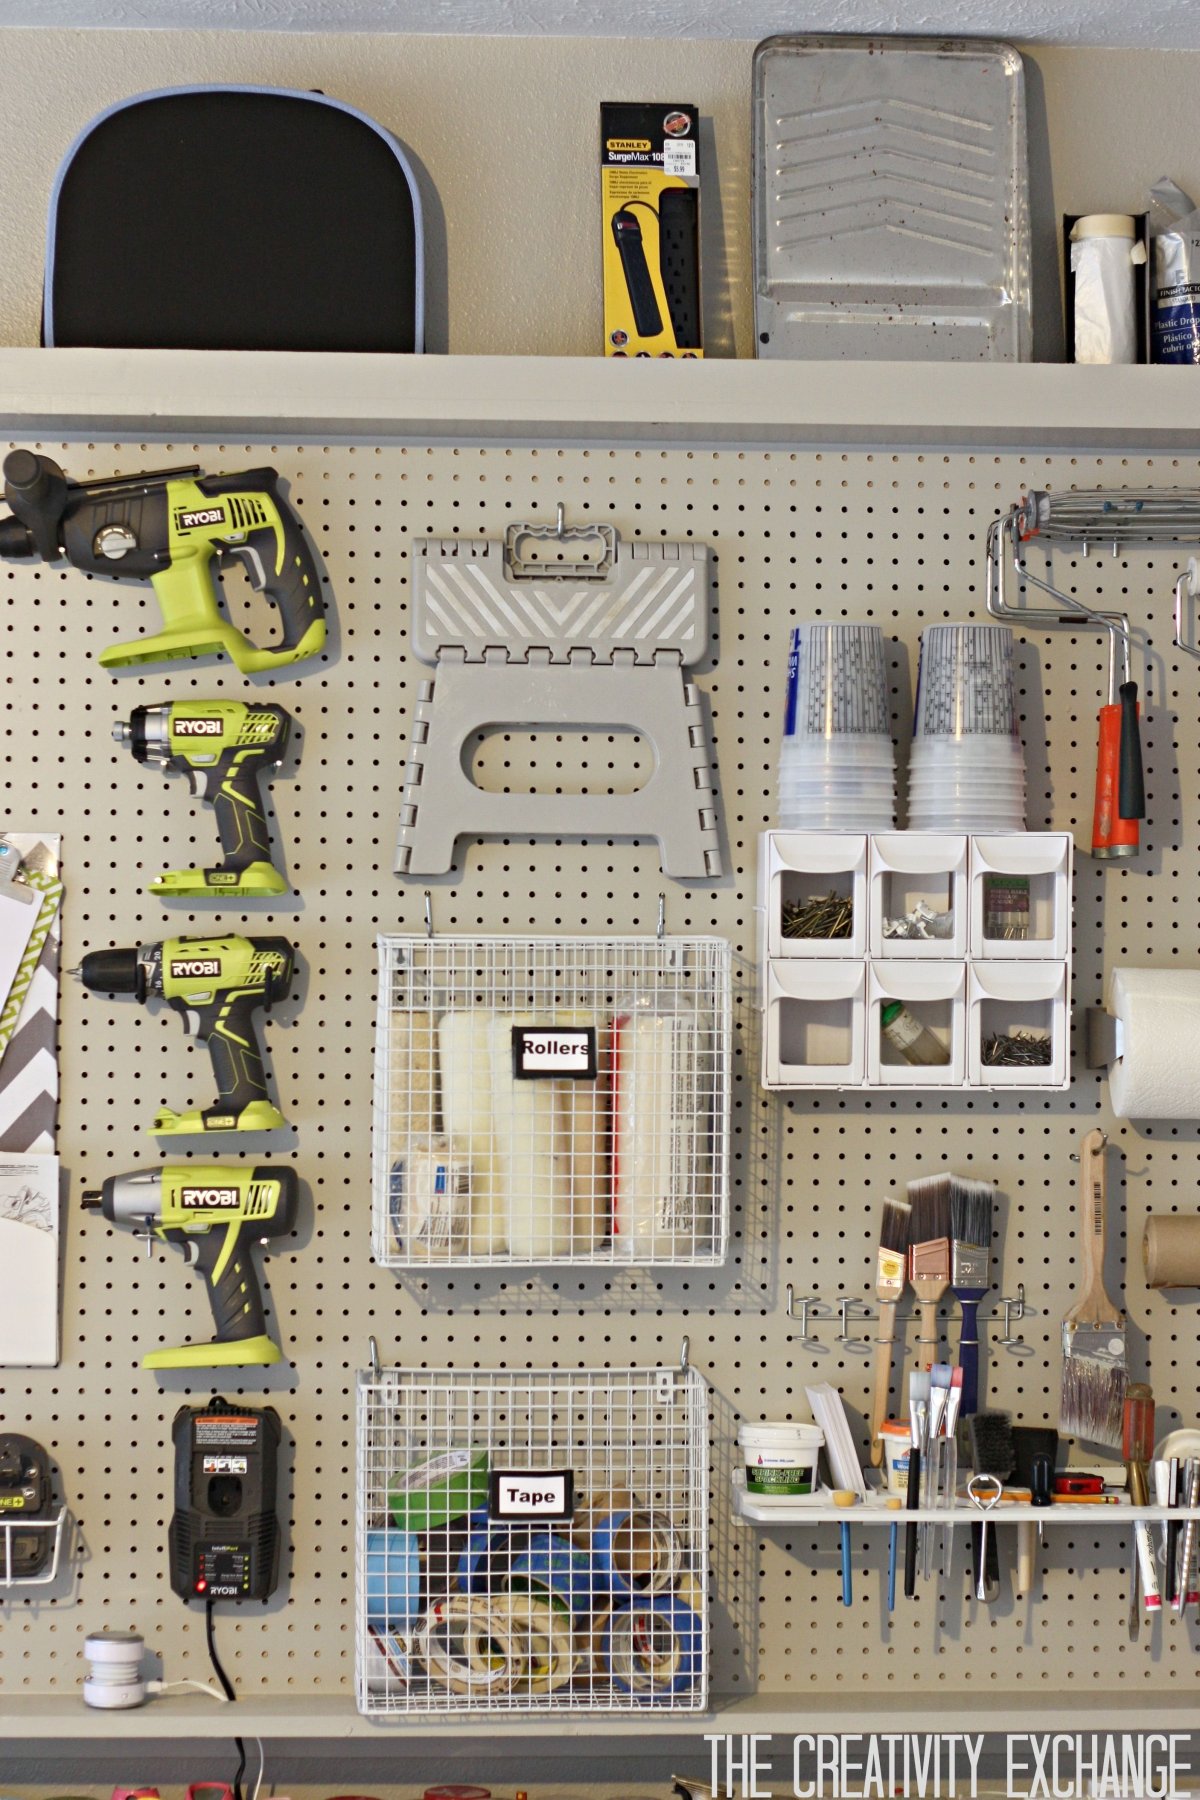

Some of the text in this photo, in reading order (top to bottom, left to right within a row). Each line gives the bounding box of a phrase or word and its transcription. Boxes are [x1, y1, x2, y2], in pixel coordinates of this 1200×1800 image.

[609, 141, 648, 149] STANLEY
[608, 152, 649, 162] SurgeMax
[1162, 344, 1184, 354] cubrir
[182, 509, 222, 526] RYOBI
[174, 720, 221, 734] RYOBI
[171, 961, 219, 976] RYOBI
[522, 1040, 588, 1055] Rollers
[183, 1190, 237, 1206] RYOBI
[507, 1488, 556, 1506] Tape
[210, 1586, 238, 1595] RYOBI
